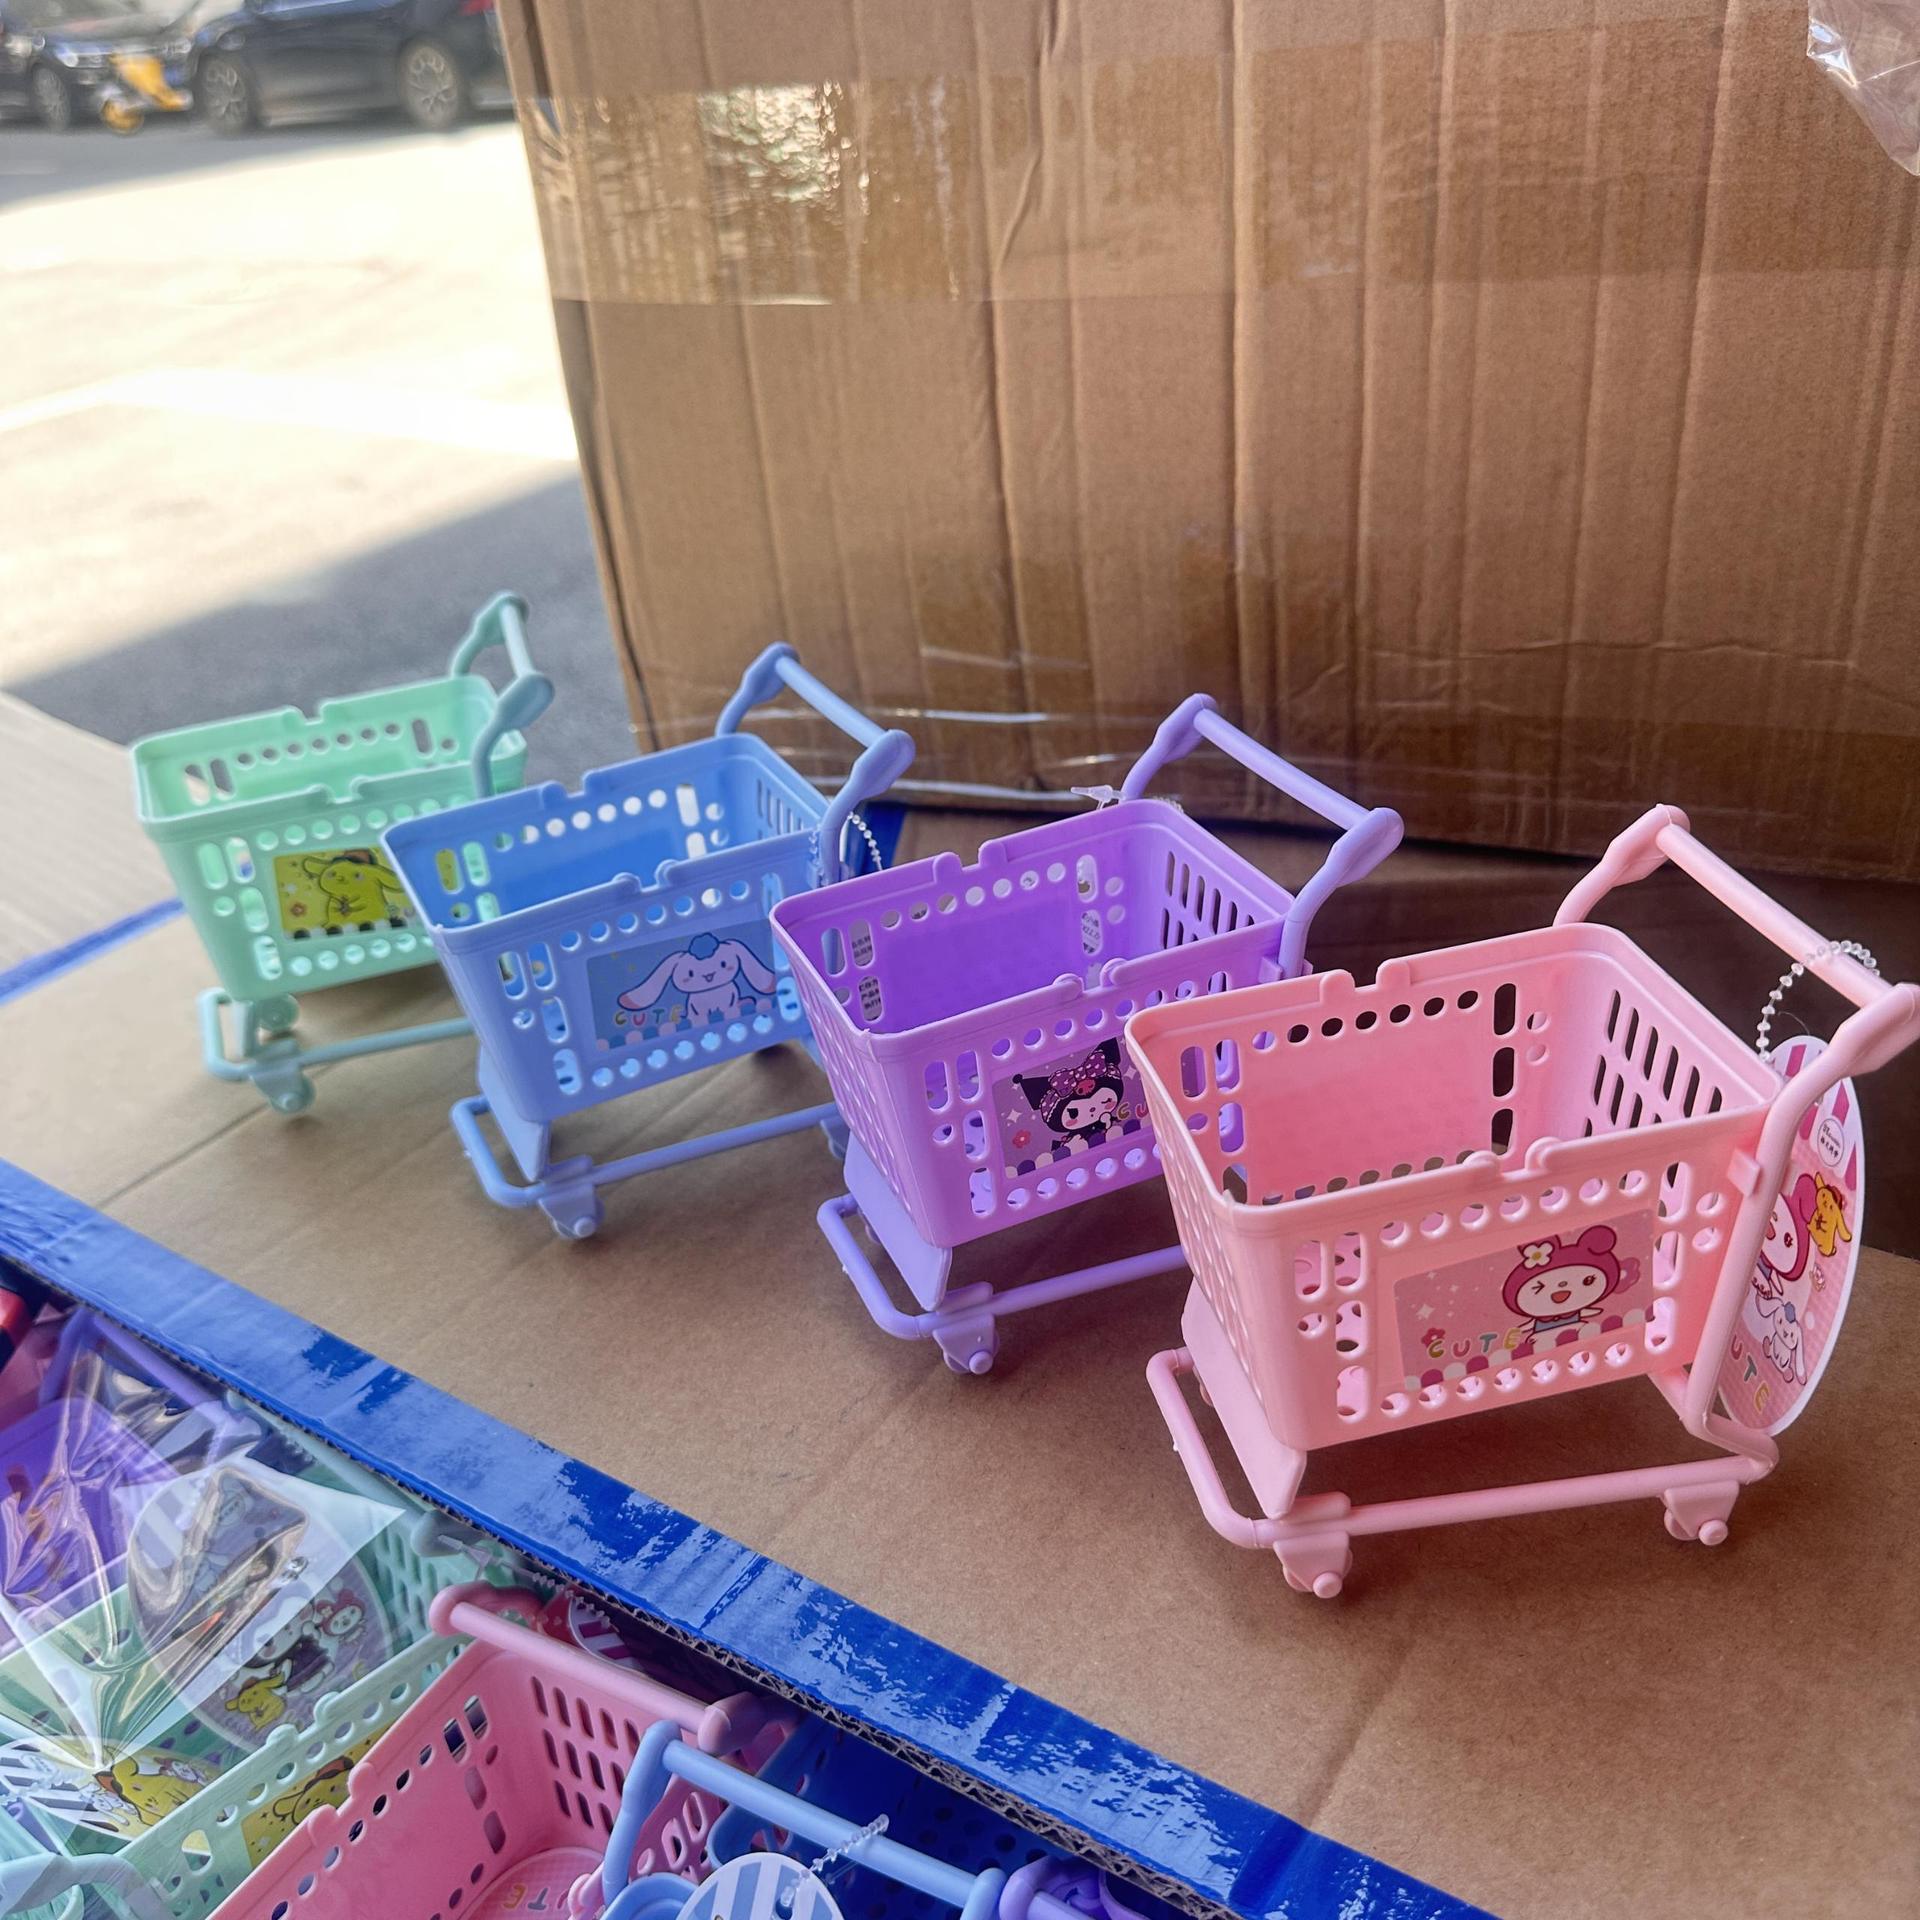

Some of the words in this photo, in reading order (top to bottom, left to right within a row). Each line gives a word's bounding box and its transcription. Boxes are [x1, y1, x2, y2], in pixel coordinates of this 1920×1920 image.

[613, 1005, 684, 1027] CUTE
[1117, 1102, 1150, 1120] CU
[1427, 1327, 1522, 1359] CUTE
[1730, 1333, 1770, 1414] UTE
